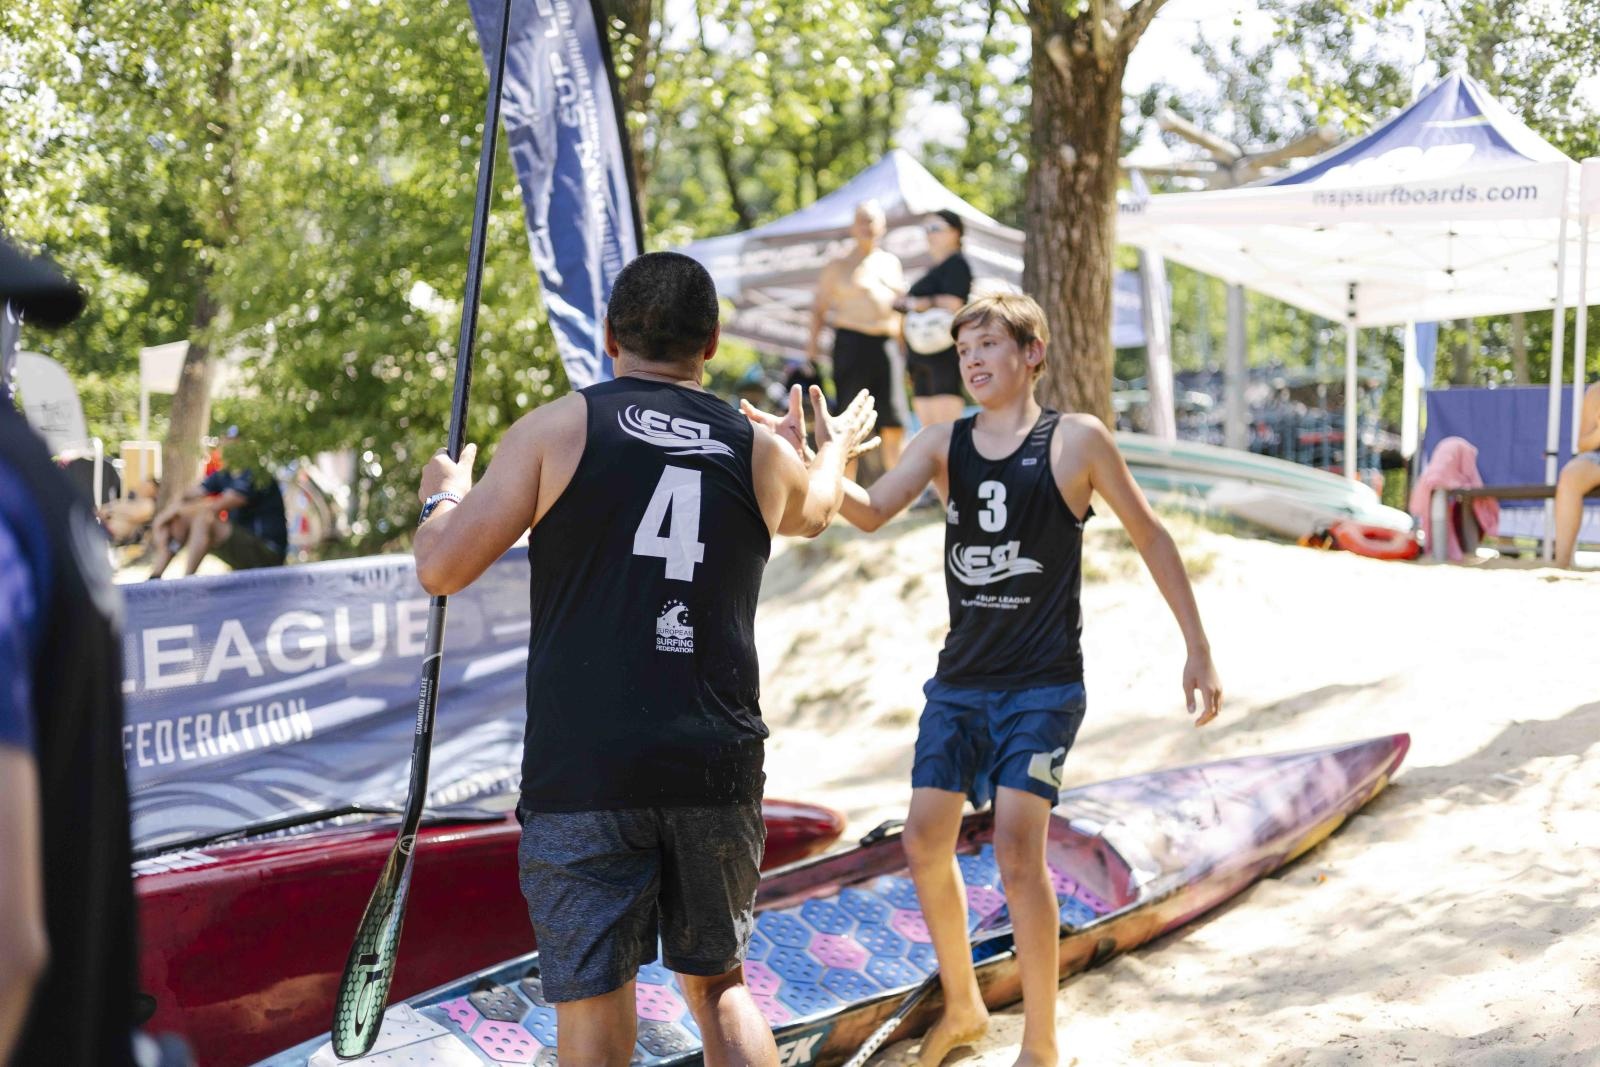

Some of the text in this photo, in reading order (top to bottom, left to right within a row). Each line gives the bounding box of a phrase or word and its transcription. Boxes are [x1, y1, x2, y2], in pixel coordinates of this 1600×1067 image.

[549, 52, 587, 128] SUP
[1312, 184, 1538, 209] nspsurfboards.com
[978, 480, 1008, 533] 3
[632, 464, 706, 582] 4
[998, 595, 1032, 604] LEAGUE
[656, 628, 693, 637] EUROPEAN
[656, 637, 694, 648] SURFING
[655, 644, 694, 653] FEDERATION
[420, 677, 428, 697] ELITE
[416, 698, 425, 734] DIAMOND
[121, 697, 313, 770] FEDERATION
